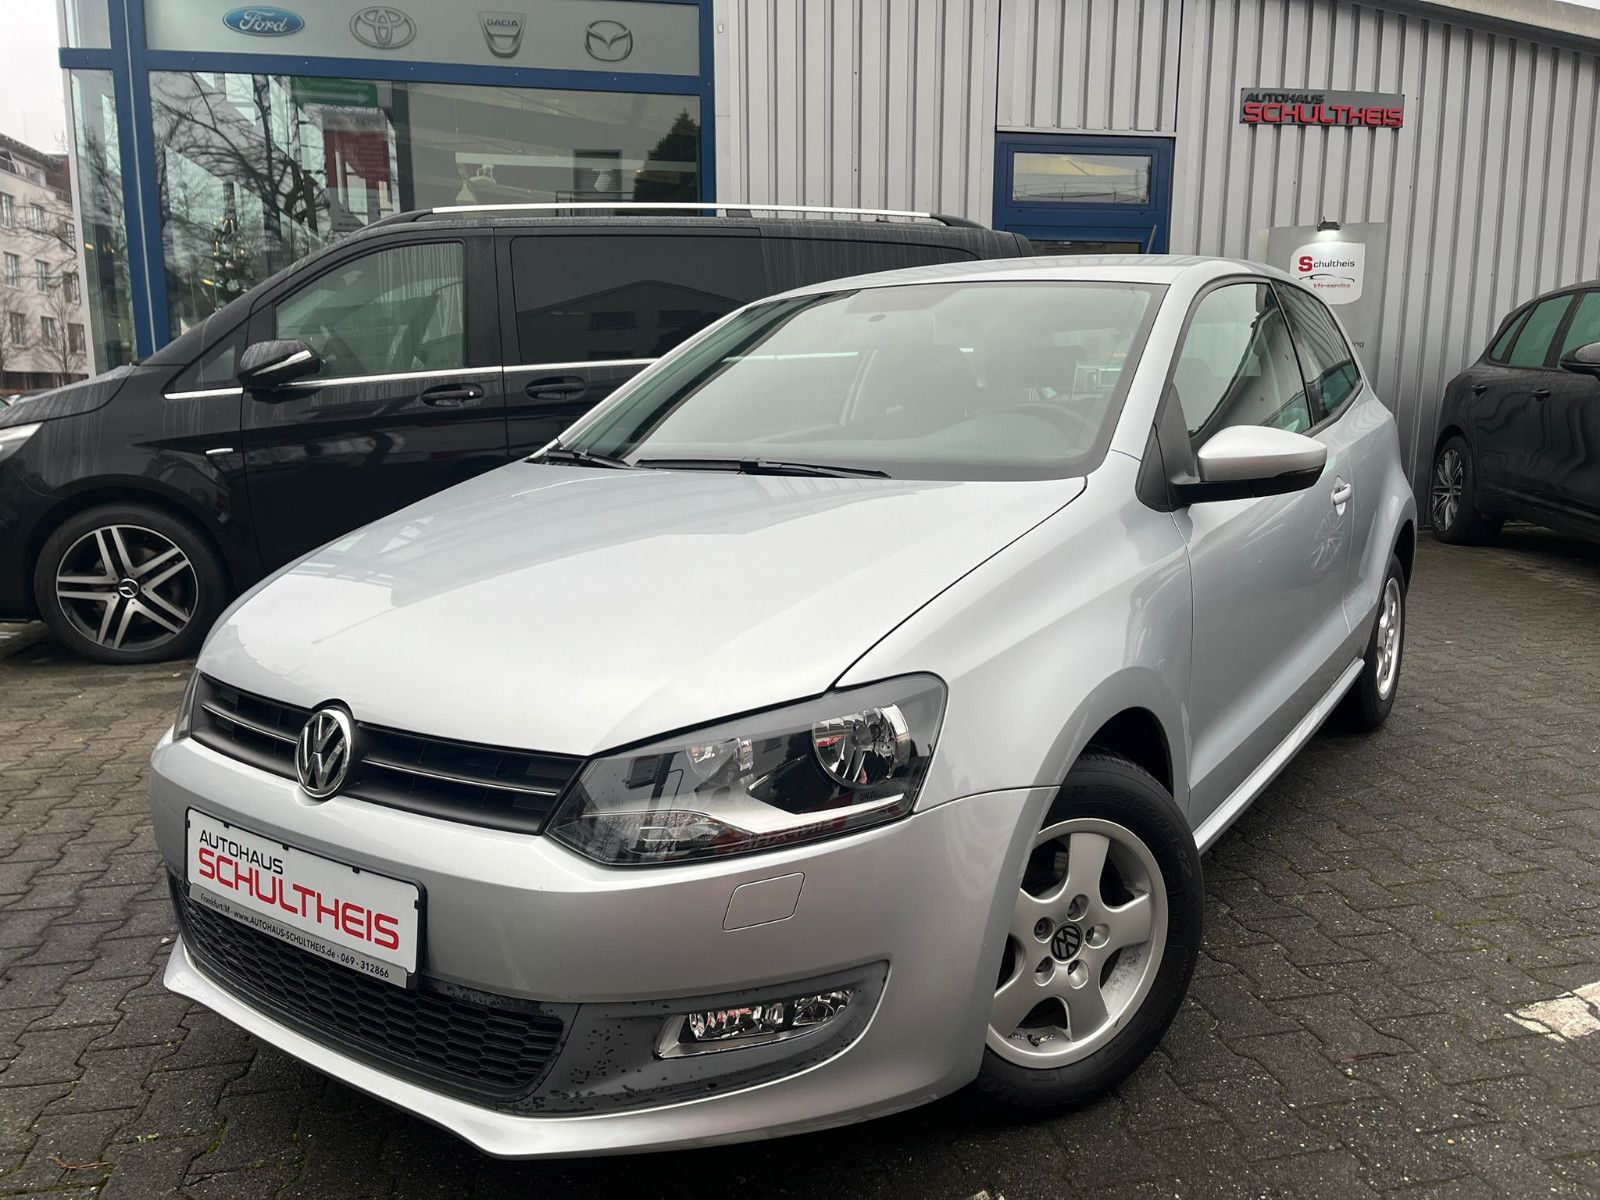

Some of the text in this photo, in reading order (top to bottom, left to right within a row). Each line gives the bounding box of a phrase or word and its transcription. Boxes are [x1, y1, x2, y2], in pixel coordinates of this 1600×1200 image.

[239, 9, 288, 32] Ford
[486, 18, 519, 27] DACIA
[1244, 92, 1326, 105] AUTOHAUS
[1243, 102, 1404, 127] SCHULTHEIS
[1298, 255, 1356, 272] Schultheis
[199, 829, 284, 875] AUTOHAUS
[198, 846, 400, 951] SCHULTHEIS
[340, 953, 355, 965] 069
[360, 961, 390, 978] 312866
